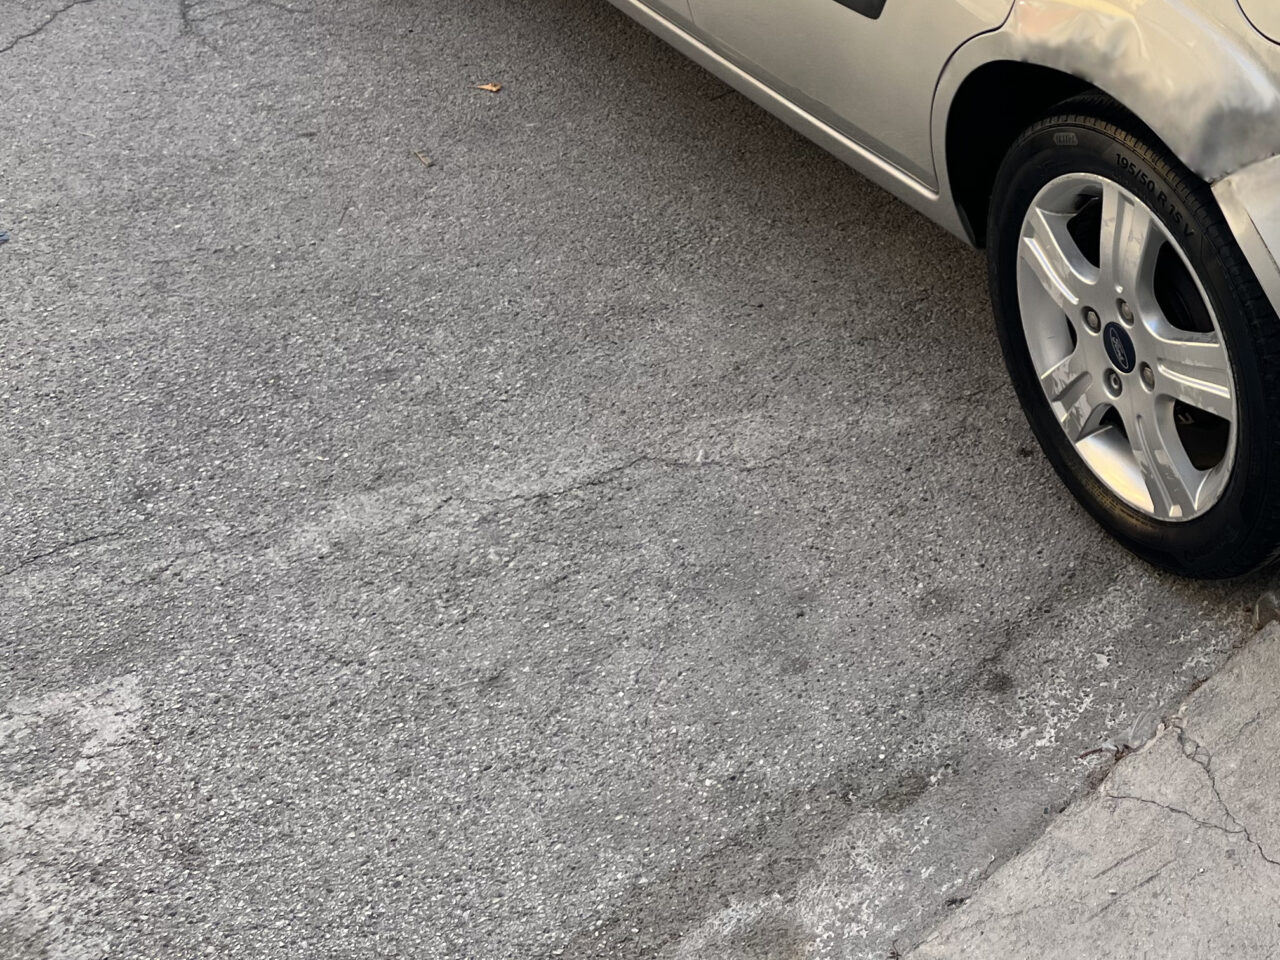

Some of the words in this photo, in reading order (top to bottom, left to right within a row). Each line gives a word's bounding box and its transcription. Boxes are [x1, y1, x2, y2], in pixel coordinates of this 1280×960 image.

[1115, 153, 1155, 193] 195/50
[1157, 194, 1168, 207] R
[1183, 224, 1195, 238] V
